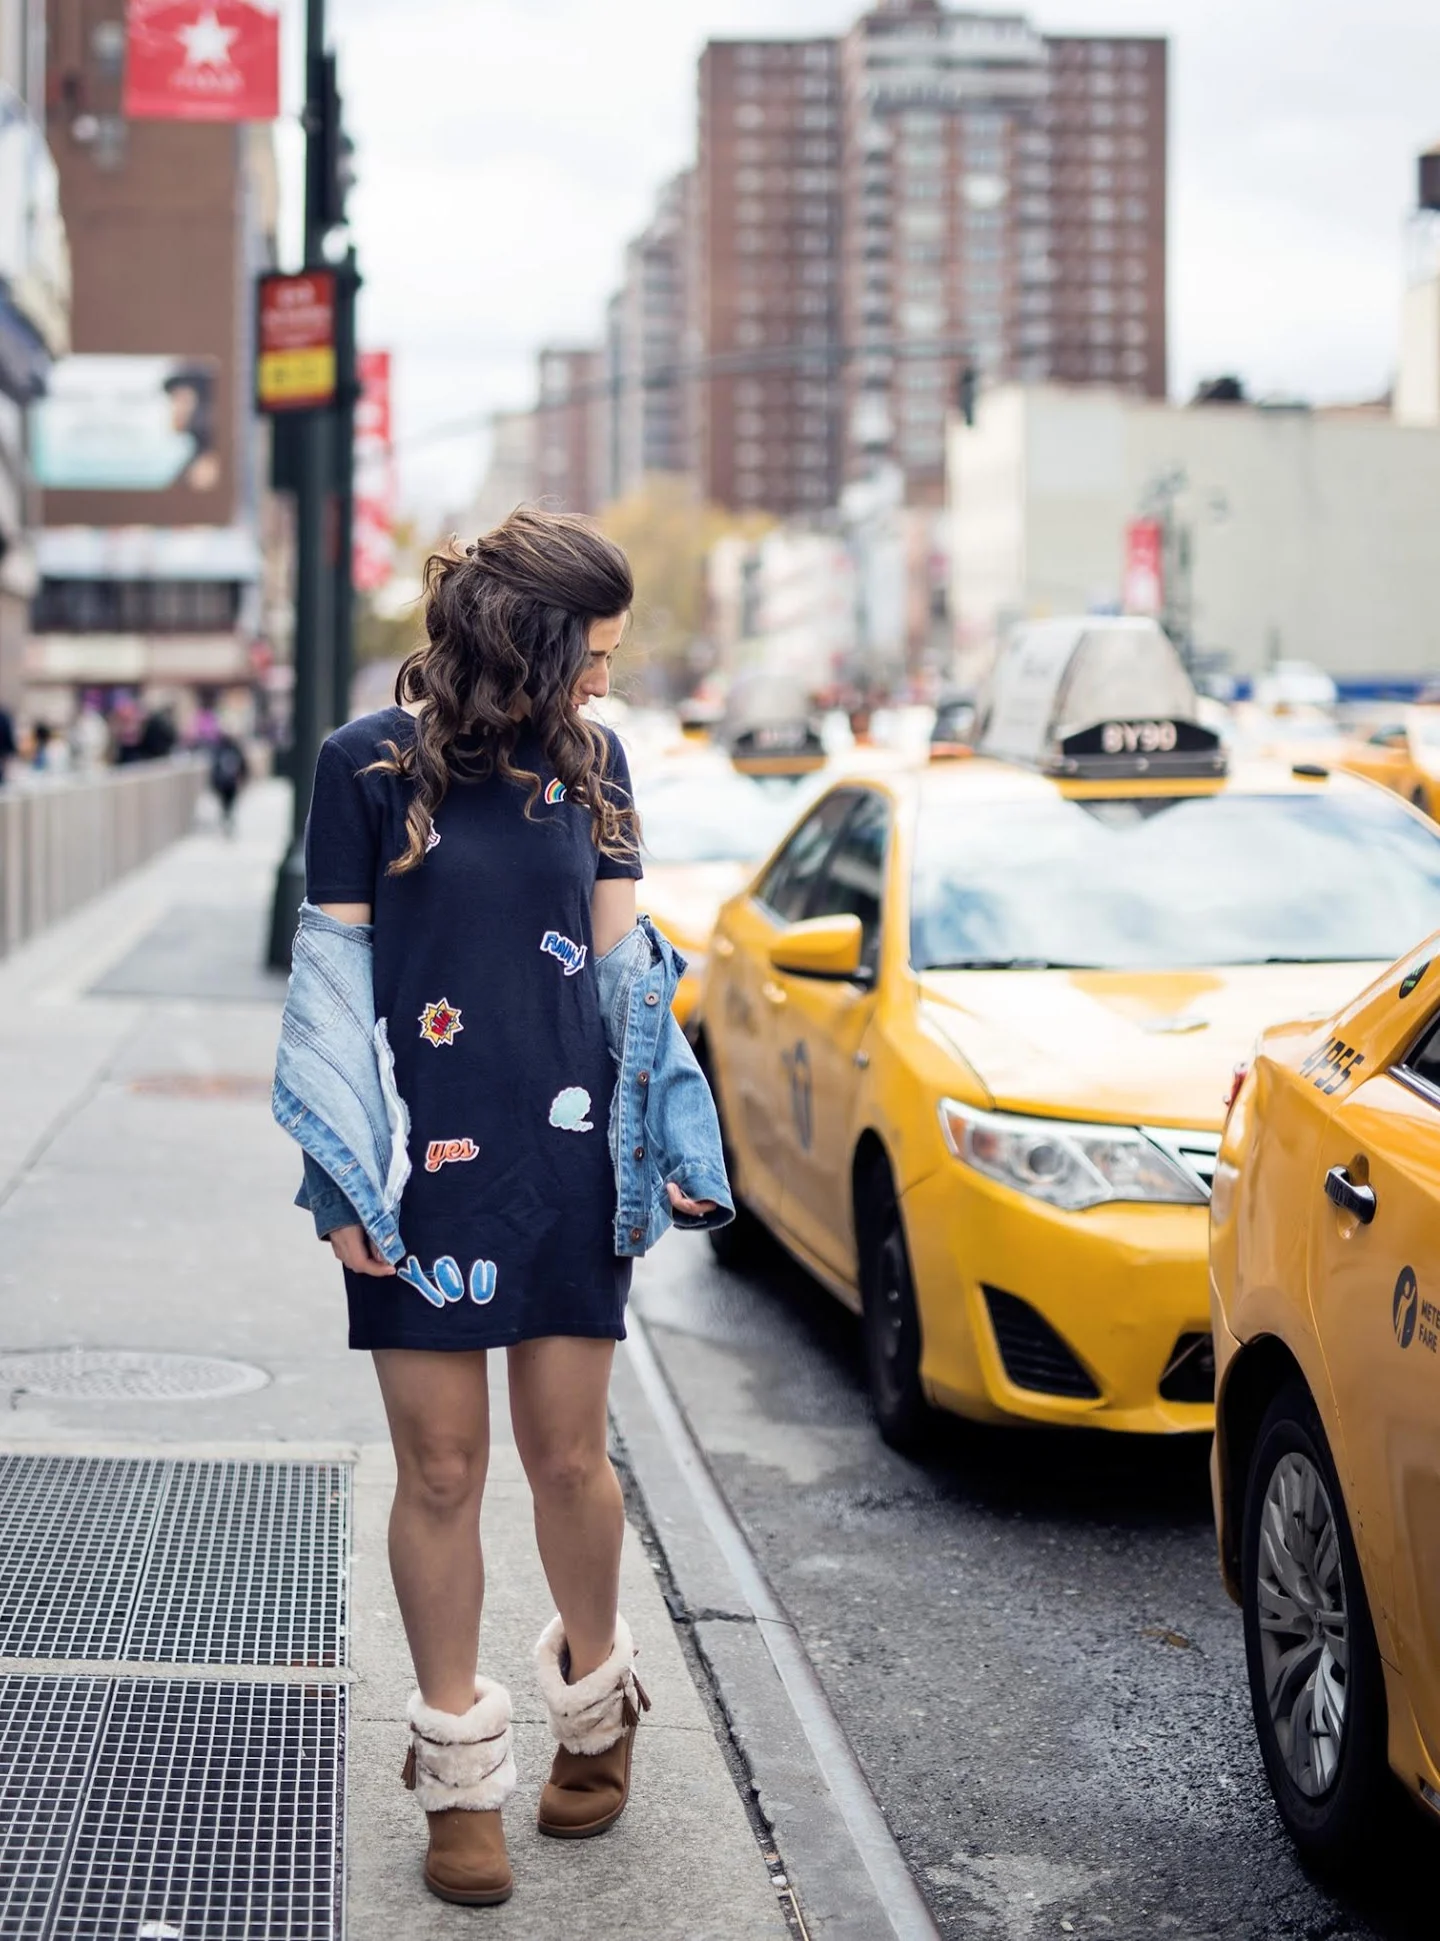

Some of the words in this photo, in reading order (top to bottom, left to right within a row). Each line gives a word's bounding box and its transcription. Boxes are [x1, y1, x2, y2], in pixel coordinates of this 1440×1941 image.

[1103, 721, 1177, 753] BY90
[1300, 1036, 1365, 1095] 4P55
[426, 1139, 479, 1171] yes
[398, 1255, 497, 1308] YOU
[1419, 1323, 1437, 1353] FARE
